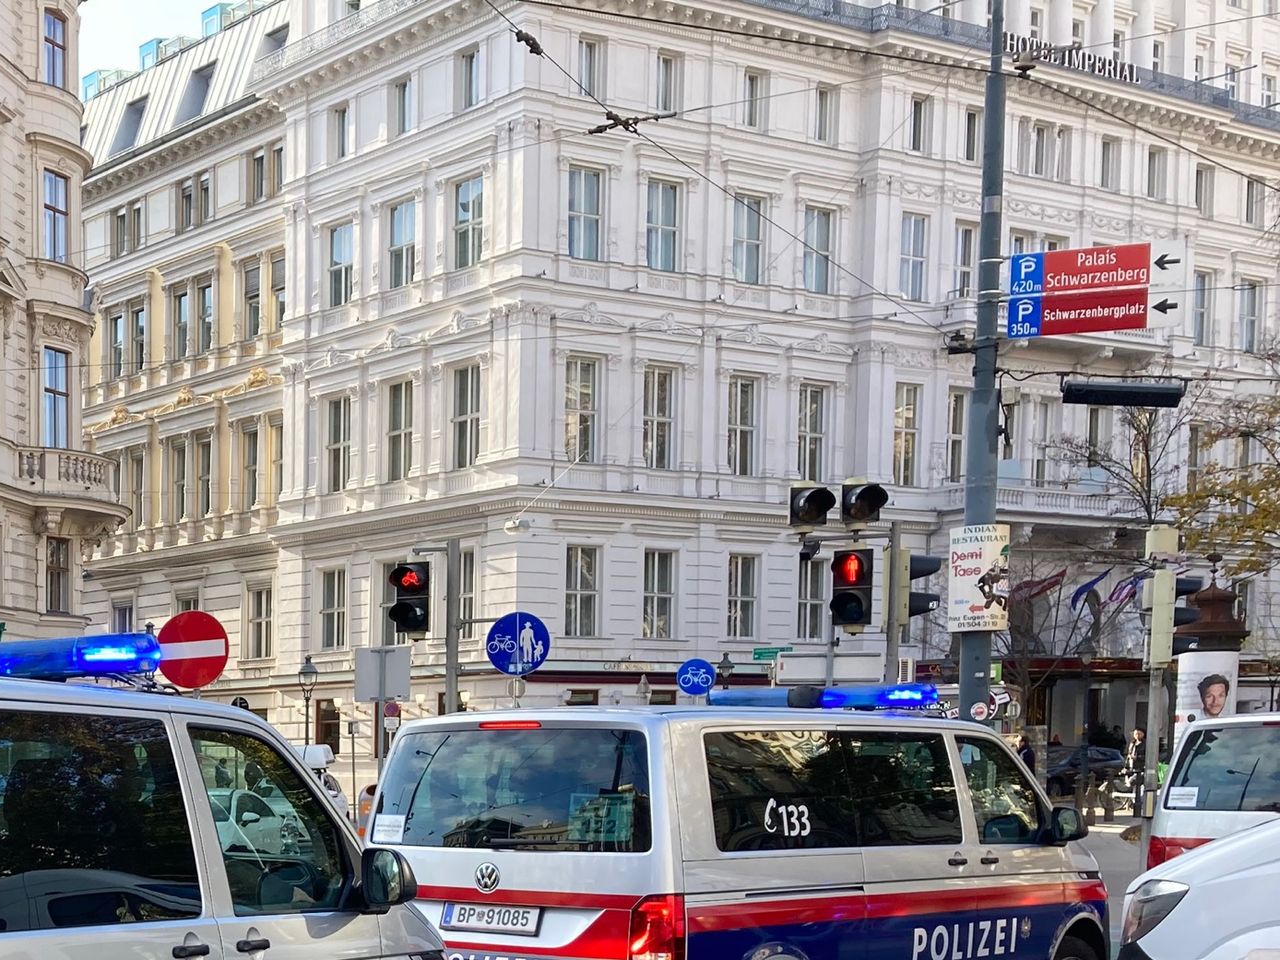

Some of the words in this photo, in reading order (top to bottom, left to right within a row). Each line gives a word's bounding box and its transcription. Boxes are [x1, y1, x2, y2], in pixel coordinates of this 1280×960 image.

[1064, 48, 1141, 84] IMPERIAL
[1077, 249, 1117, 267] Palais
[1046, 267, 1147, 288] Schwarzenberg
[1044, 303, 1145, 321] Schwarzenbergplatz
[963, 525, 998, 534] INDIAN
[951, 535, 1007, 545] RESTAURANT
[951, 547, 982, 565] Demi
[951, 565, 982, 577] Tass
[778, 804, 811, 836] 133
[457, 906, 476, 924] BP
[485, 908, 531, 927] 91085
